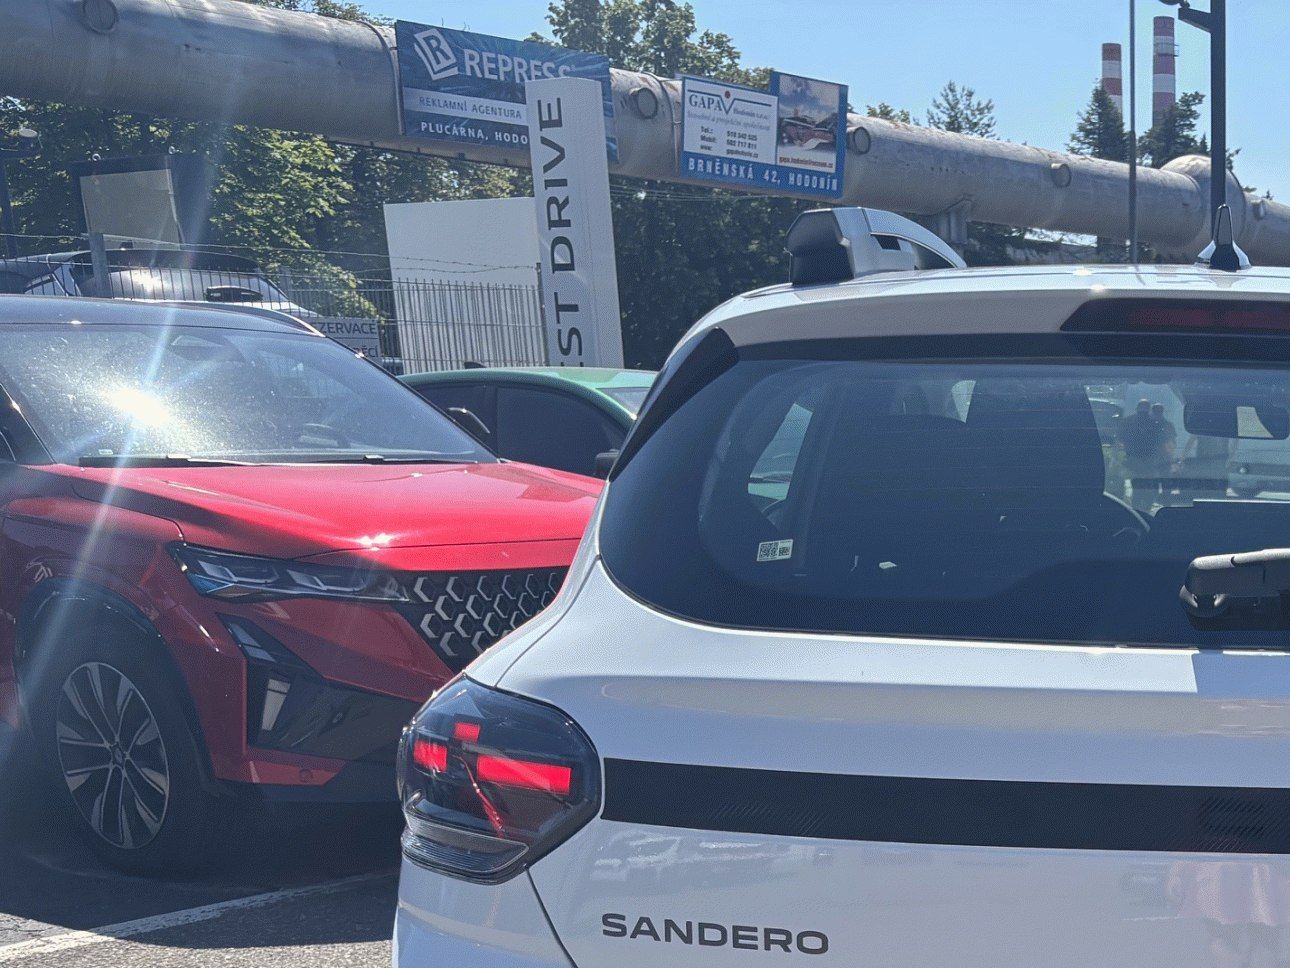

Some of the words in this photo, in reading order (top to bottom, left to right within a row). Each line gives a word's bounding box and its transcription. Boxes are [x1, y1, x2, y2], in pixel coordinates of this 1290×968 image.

[419, 96, 468, 113] REKLAMNÍ
[472, 103, 522, 119] AGENTURA
[689, 93, 723, 112] GAPA
[495, 131, 529, 145] HODO
[537, 97, 575, 274] DRIVE
[688, 157, 754, 180] BRNĚNSKÁ
[763, 169, 781, 185] 42,
[788, 172, 838, 191] HODONÍN
[309, 321, 377, 335] ZERVACE
[554, 291, 584, 367] ST
[601, 912, 829, 955] SANDERO
